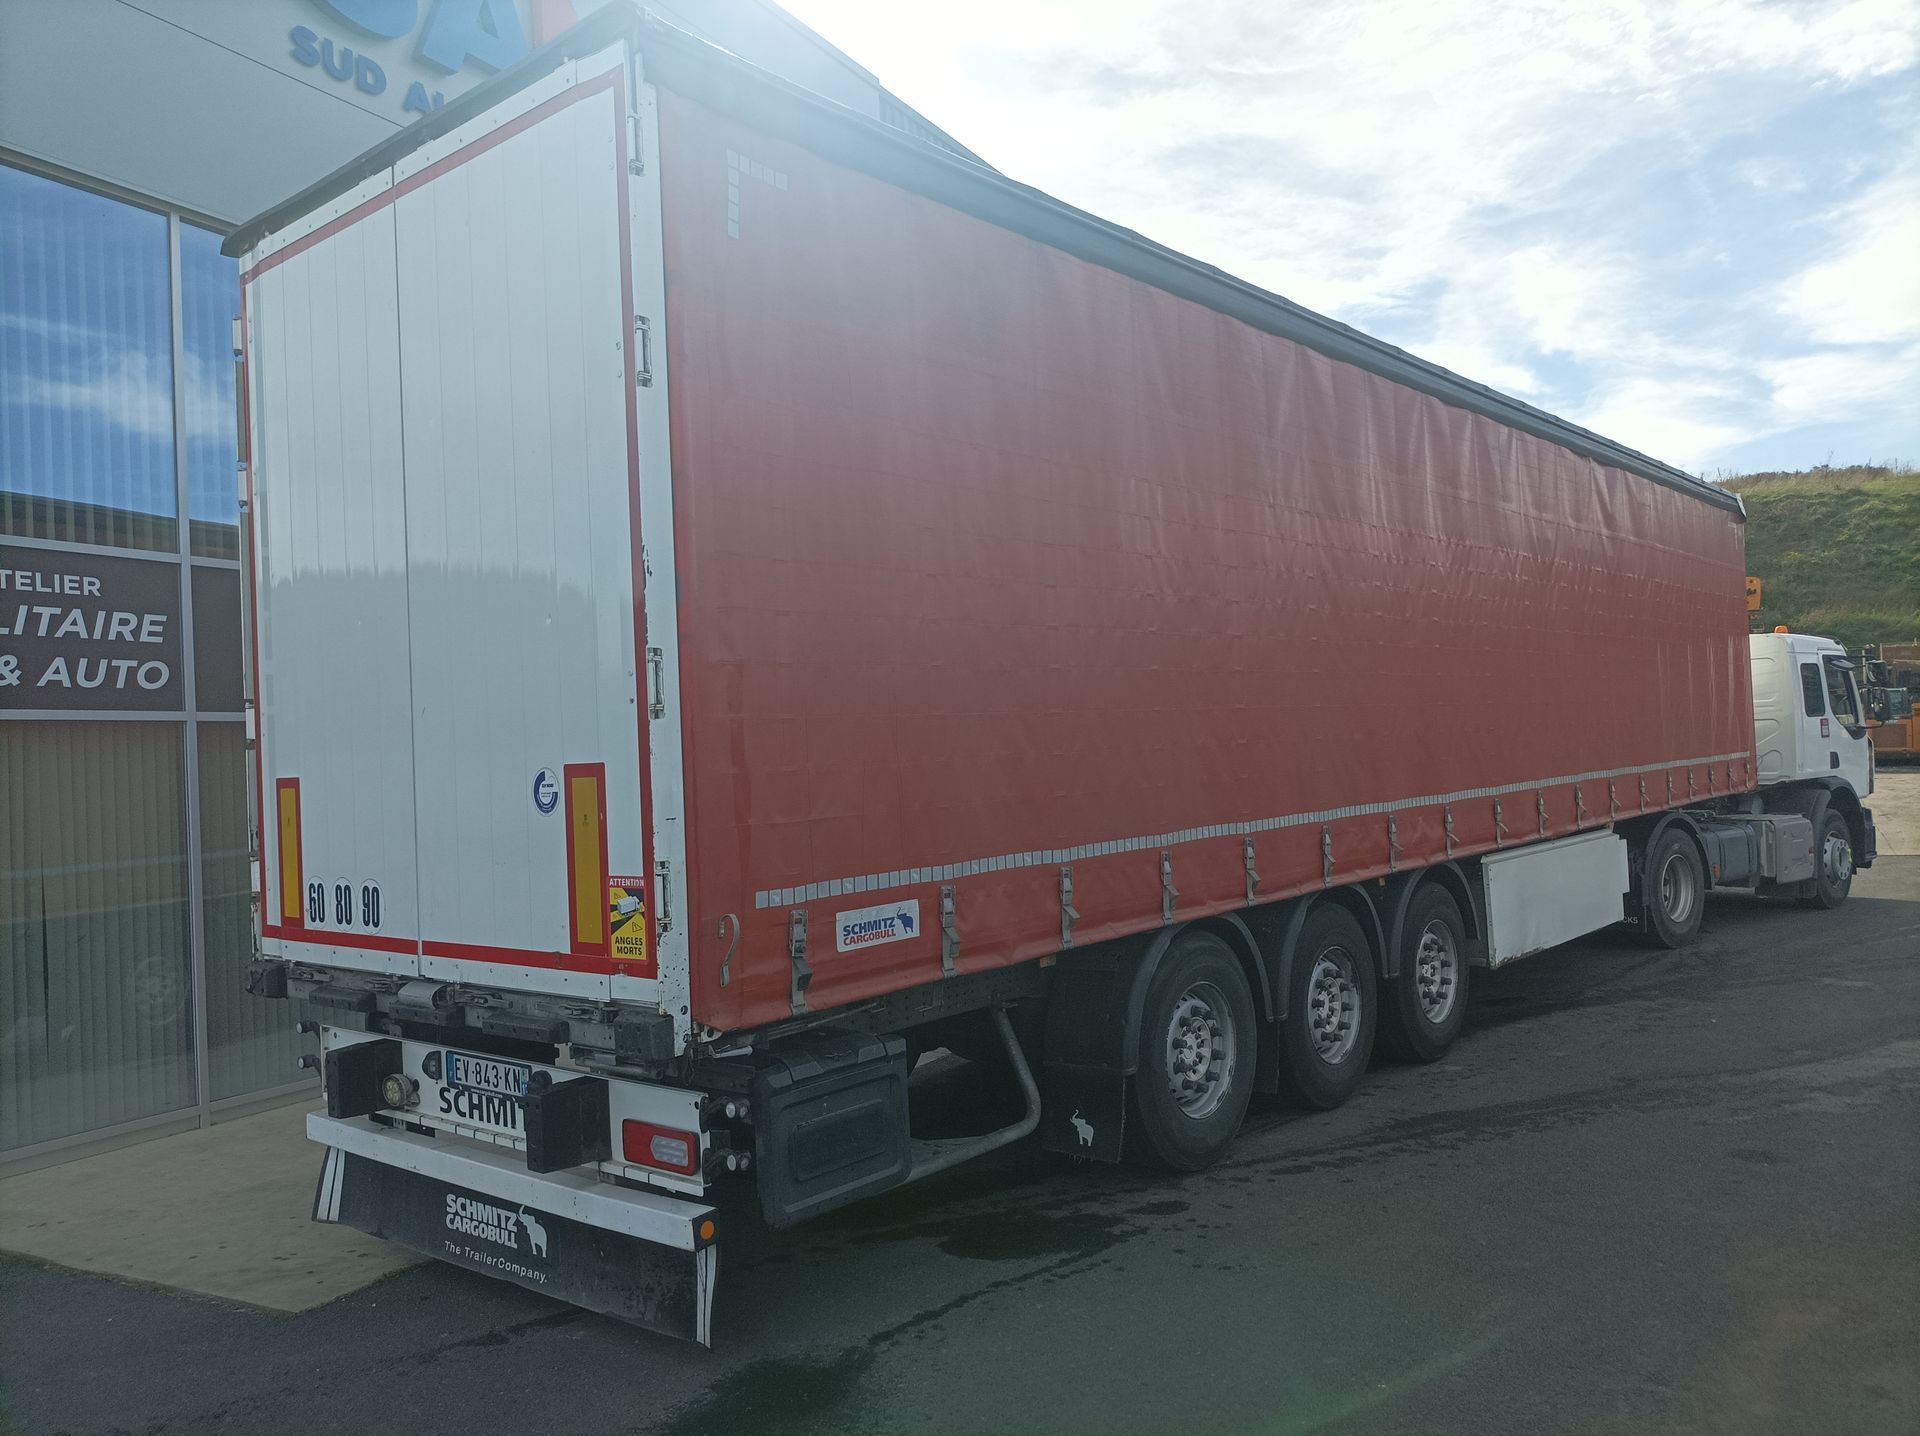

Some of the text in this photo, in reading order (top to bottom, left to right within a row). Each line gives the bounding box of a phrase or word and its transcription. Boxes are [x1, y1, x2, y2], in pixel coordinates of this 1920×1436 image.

[289, 25, 388, 95] SUD
[0, 569, 101, 597] TELIER
[0, 654, 170, 690] & AUTO
[609, 878, 645, 887] ATTENTION
[308, 882, 380, 929] 60 80 90
[843, 916, 896, 937] SCHMITZ
[843, 928, 897, 946] CARGOBULL
[614, 936, 644, 946] ANGLES
[616, 945, 643, 956] MORTS
[446, 1193, 518, 1233] SCHMITZ
[446, 1213, 518, 1249] CARGOBULL
[444, 1240, 461, 1255] The
